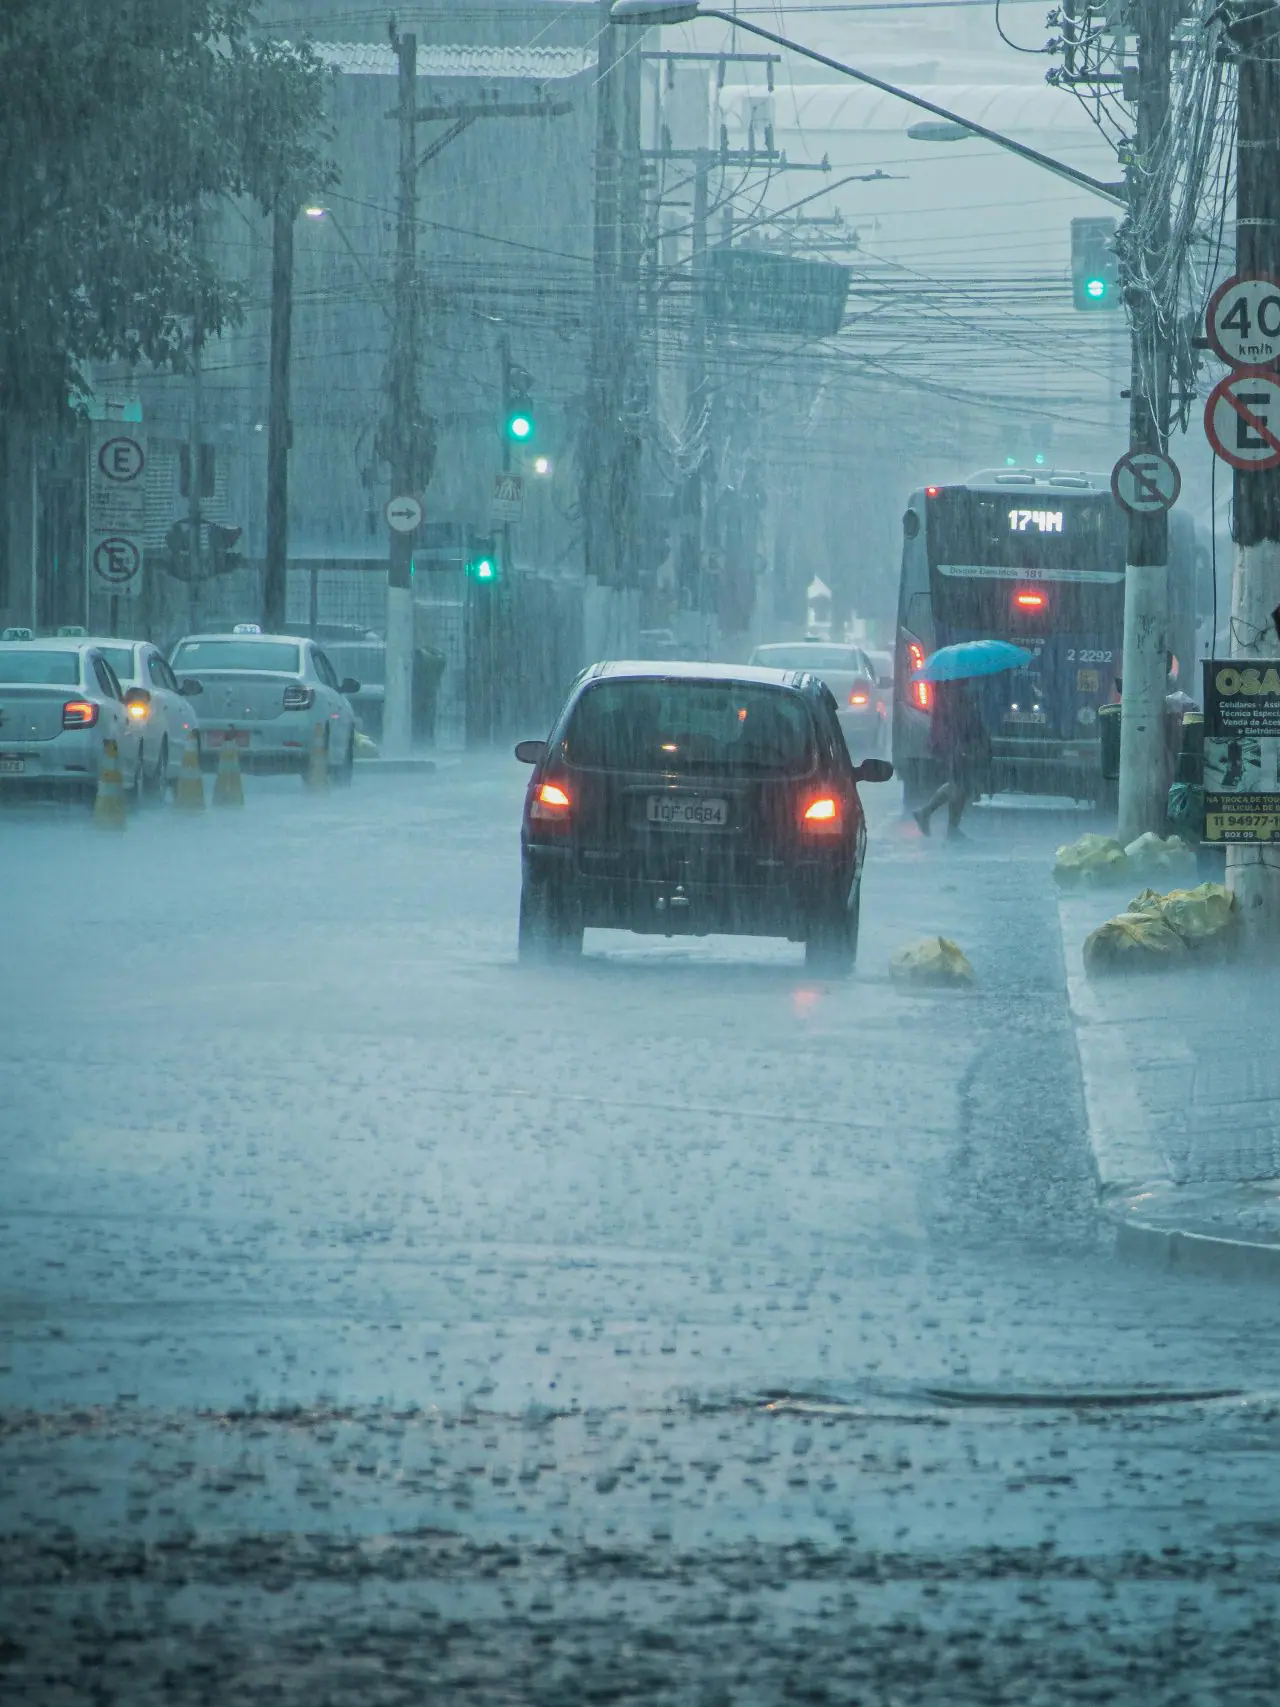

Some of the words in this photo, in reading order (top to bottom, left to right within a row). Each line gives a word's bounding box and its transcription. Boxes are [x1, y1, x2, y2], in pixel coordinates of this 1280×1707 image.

[1239, 344, 1273, 356] km/h
[1237, 393, 1271, 449] E
[114, 448, 130, 473] E
[1134, 463, 1160, 502] E
[1008, 510, 1063, 532] 174M
[1067, 648, 1076, 661] 2
[1080, 649, 1113, 663] 2292
[1219, 701, 1256, 709] Celulares
[1220, 709, 1251, 717] Técnica
[1213, 815, 1225, 827] 11
